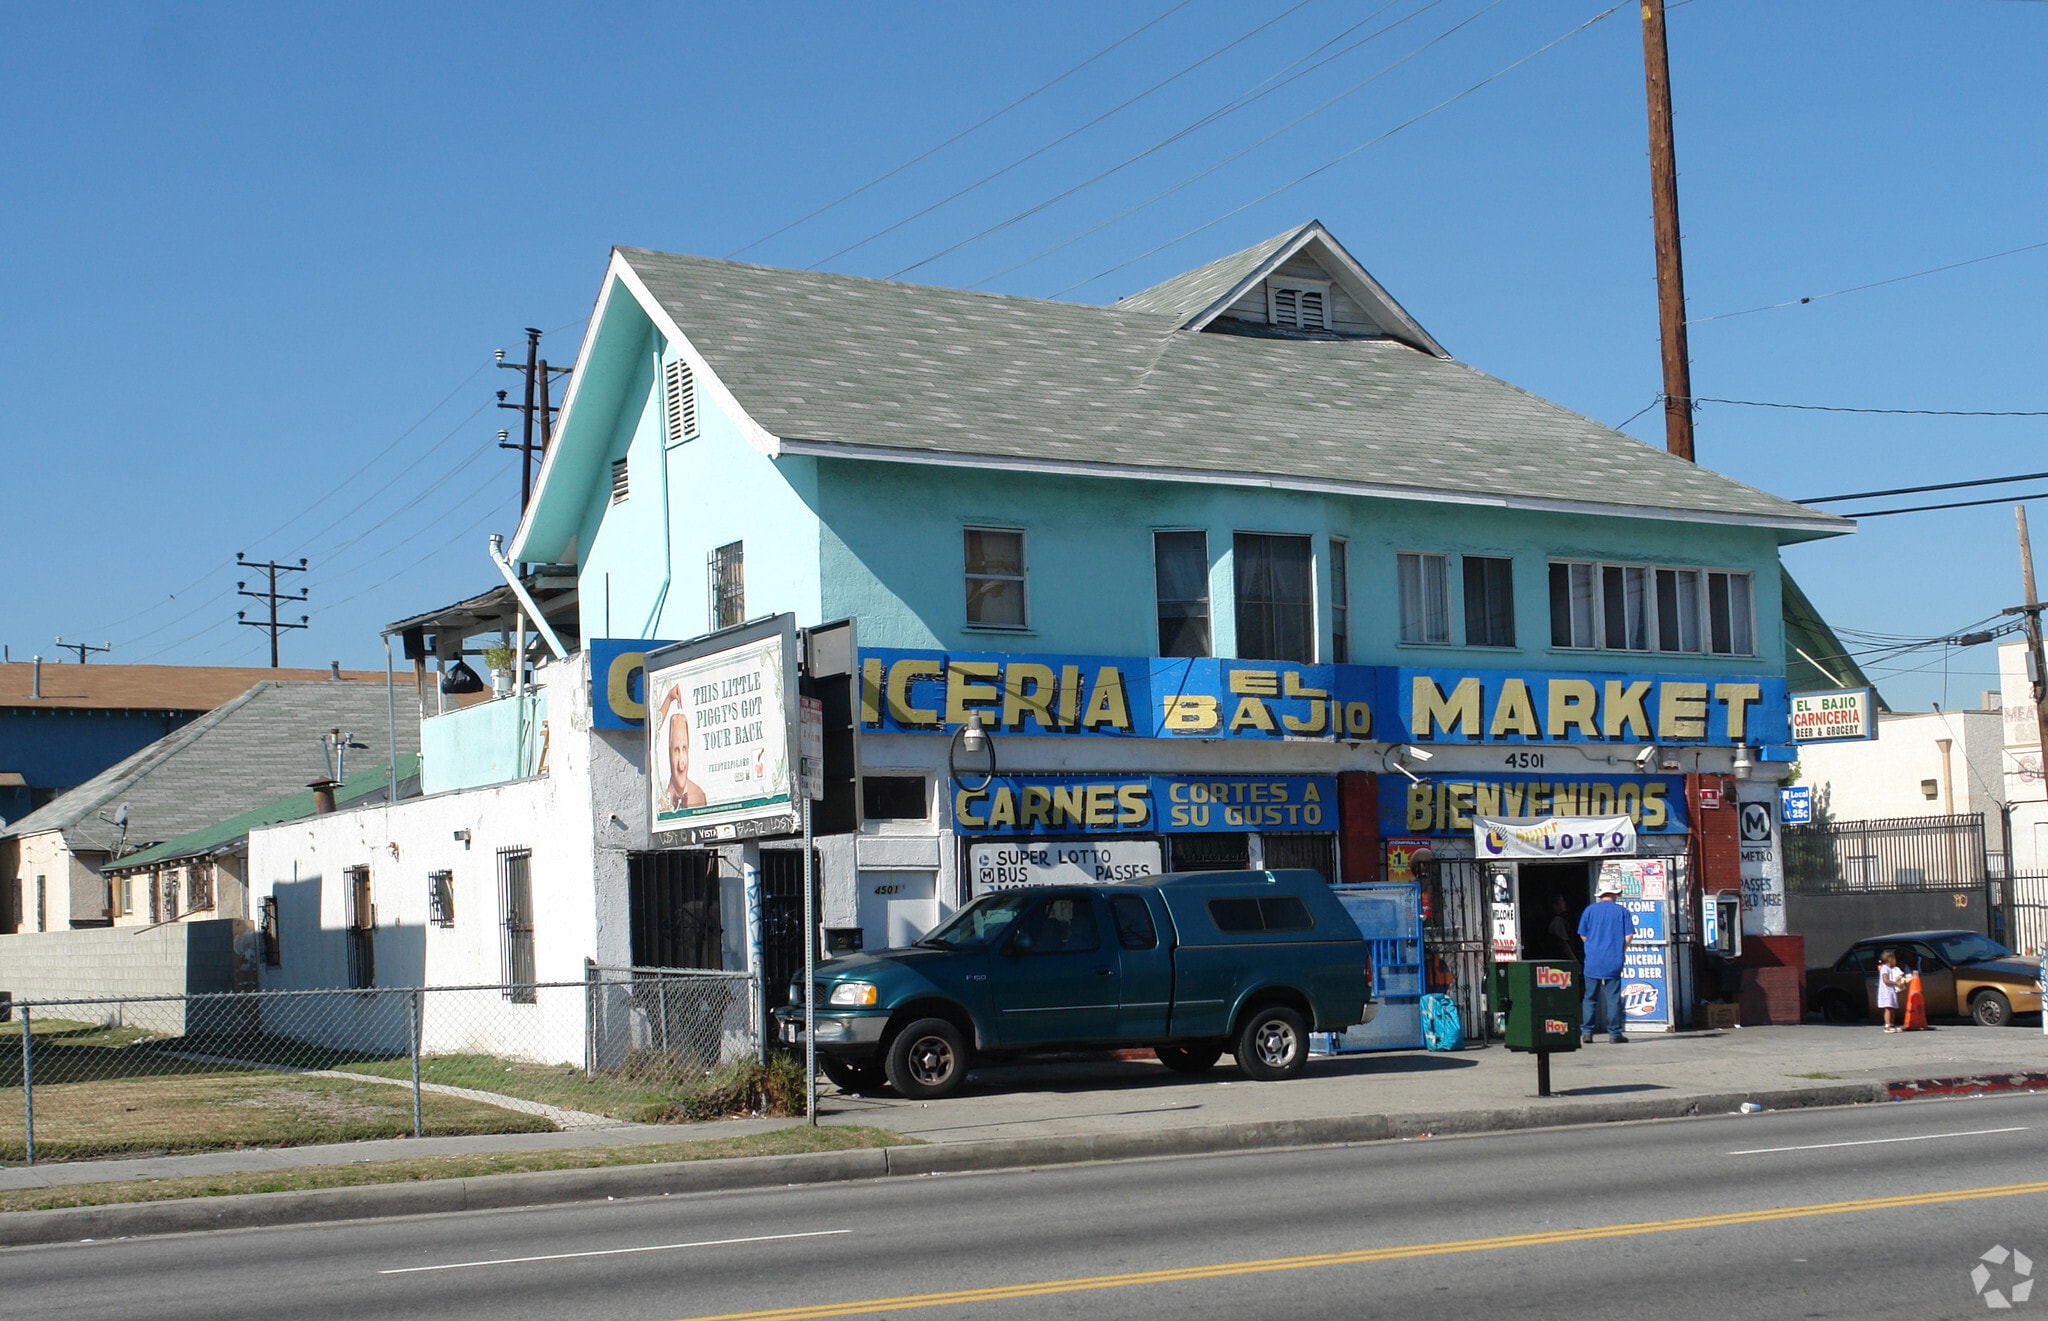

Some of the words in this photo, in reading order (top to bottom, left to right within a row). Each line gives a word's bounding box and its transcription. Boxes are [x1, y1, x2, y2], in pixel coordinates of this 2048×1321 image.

[692, 683, 719, 706] THIS
[721, 671, 761, 699] LITTLE
[1229, 669, 1327, 697] EL
[607, 652, 1134, 733] CICERIA
[696, 702, 739, 729] PIGGY'S
[741, 696, 763, 721] GOT
[1411, 676, 1761, 738] MARKET
[1796, 700, 1811, 712] EL
[1822, 697, 1856, 710] BAJIO
[1163, 694, 1372, 735] BAJIO
[1793, 709, 1860, 727] CARNICERIA
[702, 727, 731, 751] YOUR
[735, 721, 764, 745] BACK
[1796, 727, 1813, 738] BEER
[1817, 727, 1822, 736] &
[1826, 725, 1859, 736] GROCERY
[1505, 752, 1544, 769] 4501
[1169, 782, 1288, 804] CORTES
[1303, 783, 1321, 804] A
[1790, 790, 1809, 799] Local
[956, 783, 1150, 829] CARNES
[1406, 782, 1667, 831] BIENVENIDOS
[1170, 805, 1210, 827] SU
[1224, 804, 1323, 827] GUSTO
[1516, 822, 1559, 846] Super
[1544, 832, 1624, 849] LOTTO
[996, 850, 1051, 866] SUPER
[1058, 850, 1112, 865] LOTTO
[1741, 851, 1773, 862] METRO
[997, 867, 1028, 883] BUS
[1095, 864, 1151, 881] PASSES
[874, 885, 899, 895] 4501
[1615, 901, 1656, 912] LCOME
[1762, 893, 1782, 907] HERE
[1631, 914, 1640, 926] O
[1633, 927, 1655, 939] AJIO
[1624, 954, 1664, 966] NICERIA
[1536, 967, 1570, 989] Hoy
[1620, 967, 1636, 979] LD
[1638, 967, 1662, 979] BEER
[1545, 1020, 1568, 1034] Hoy
